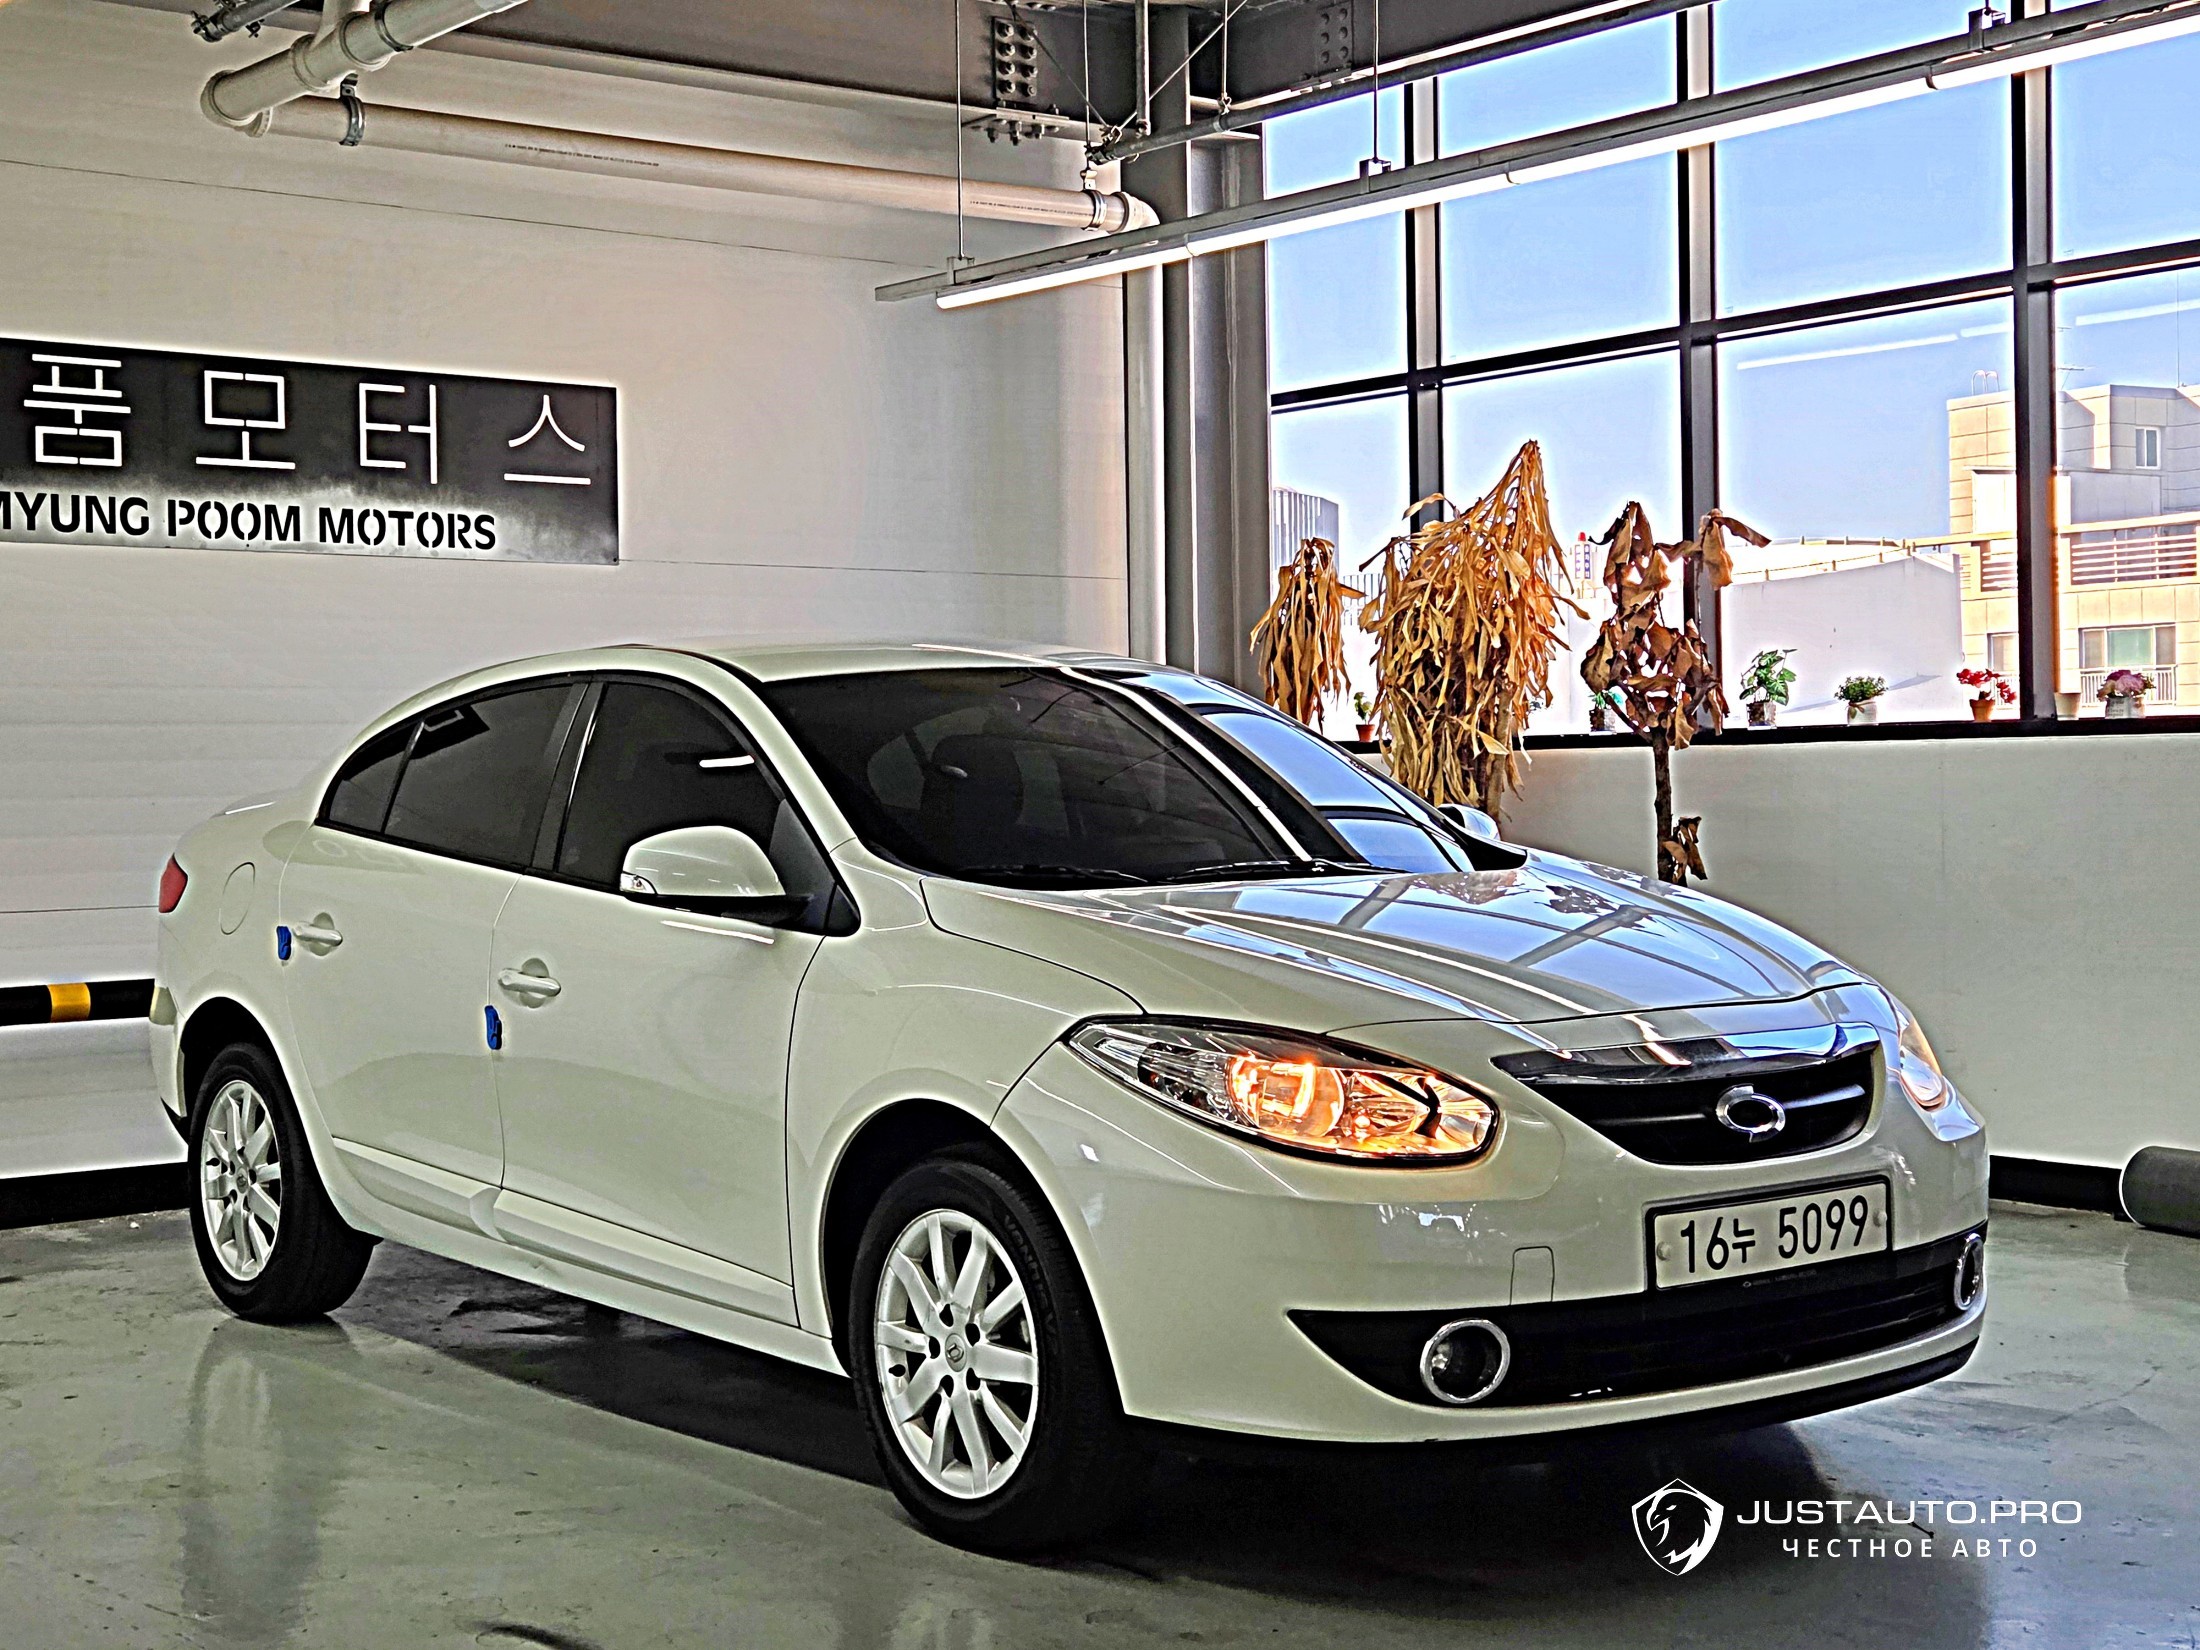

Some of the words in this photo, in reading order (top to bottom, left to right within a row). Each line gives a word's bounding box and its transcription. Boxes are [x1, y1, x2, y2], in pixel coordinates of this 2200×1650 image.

[167, 499, 301, 542] POOM
[319, 507, 496, 550] MOTORS
[1680, 1216, 1756, 1274] 16누
[1778, 1195, 1868, 1259] 5099
